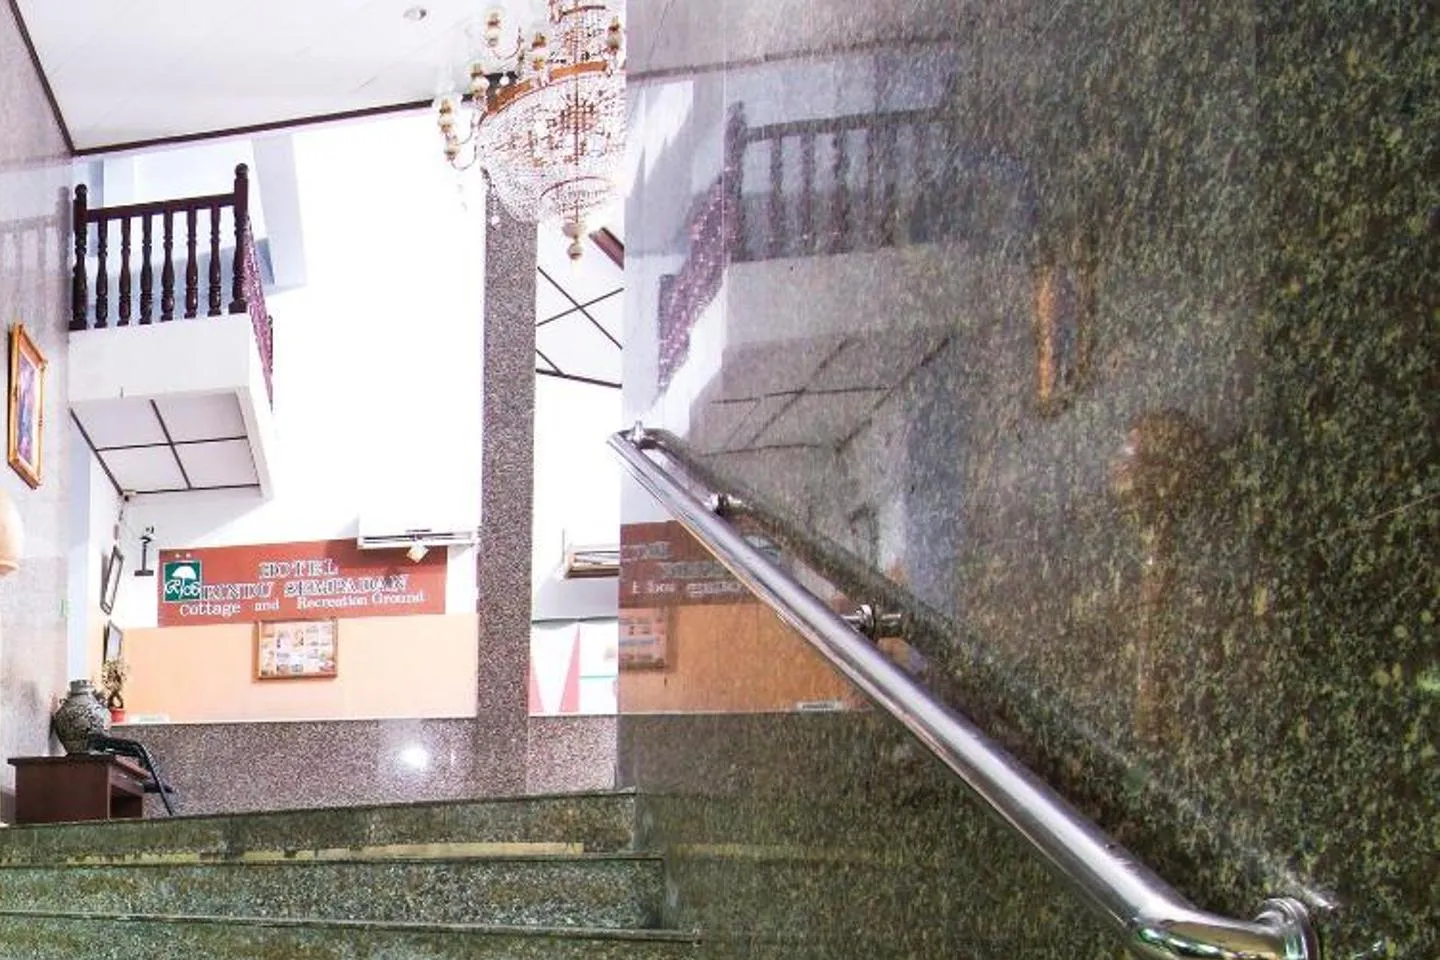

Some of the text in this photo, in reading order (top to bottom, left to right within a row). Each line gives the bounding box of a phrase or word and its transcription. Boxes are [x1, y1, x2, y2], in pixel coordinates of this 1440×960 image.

[180, 589, 426, 617] Cottage and Recreation Ground
